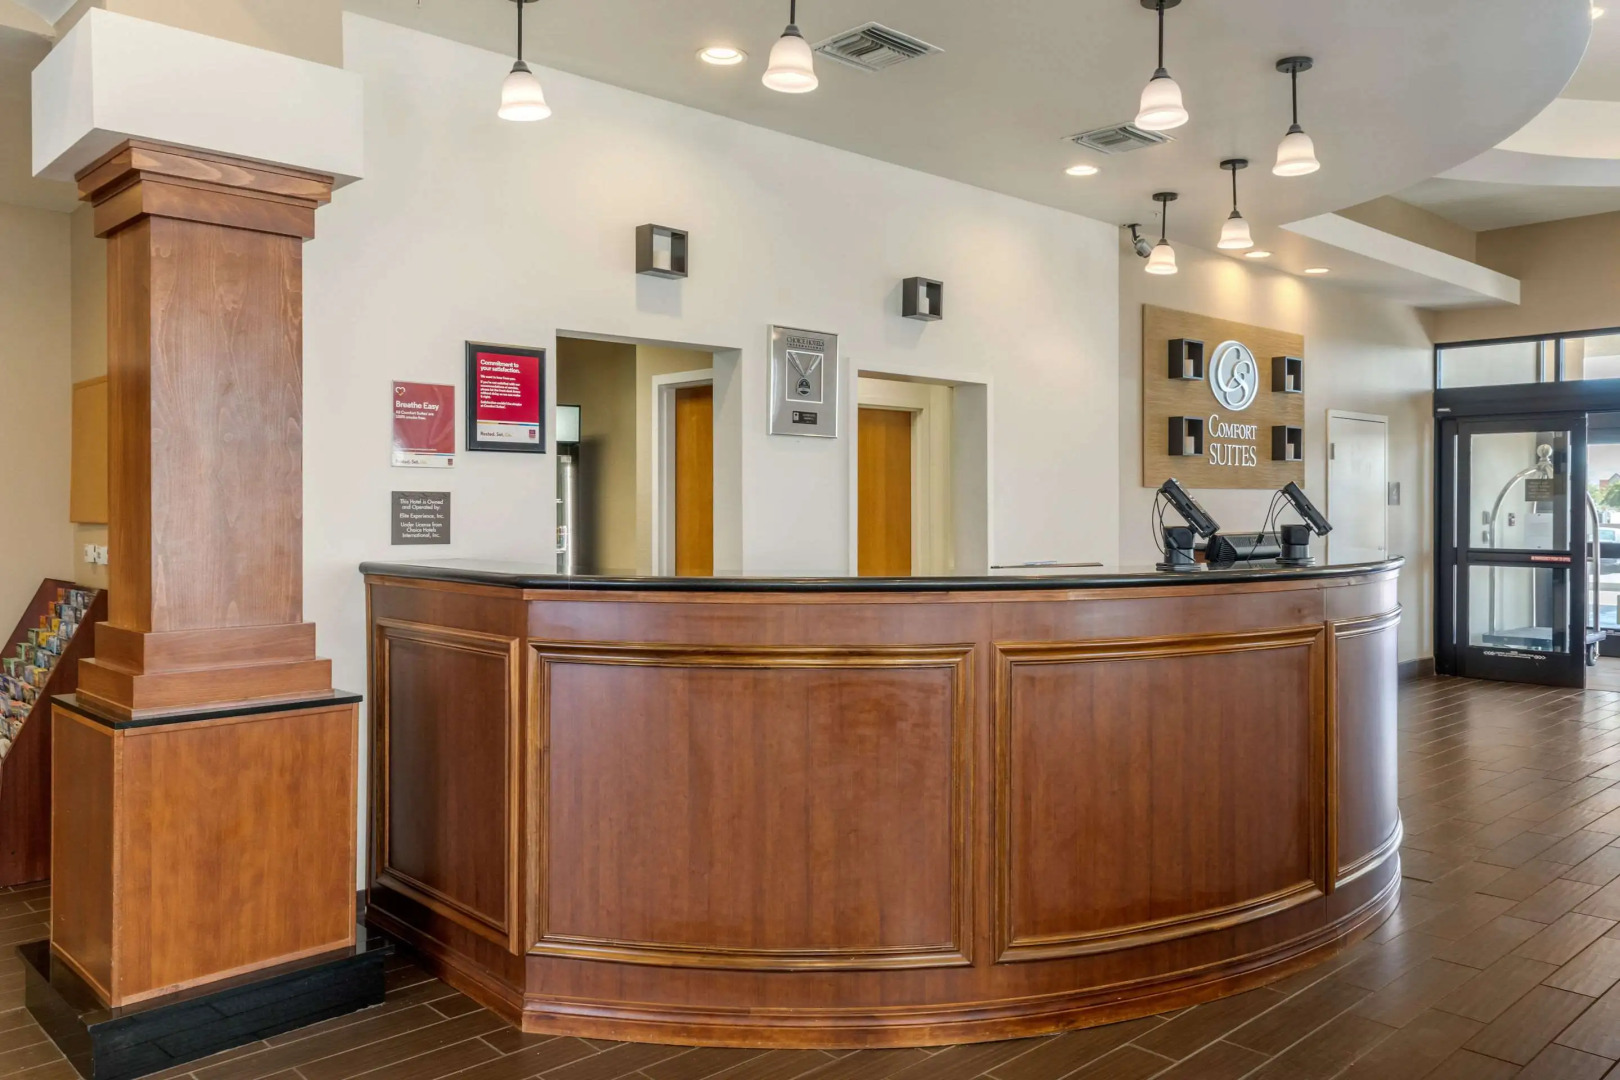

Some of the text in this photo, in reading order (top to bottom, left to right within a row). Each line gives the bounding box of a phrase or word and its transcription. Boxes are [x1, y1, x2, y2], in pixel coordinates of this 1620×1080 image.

[480, 359, 513, 367] Commitment
[396, 400, 439, 411] Breathe Easy
[1208, 414, 1257, 440] COMFORT
[1209, 442, 1257, 467] SUITES
